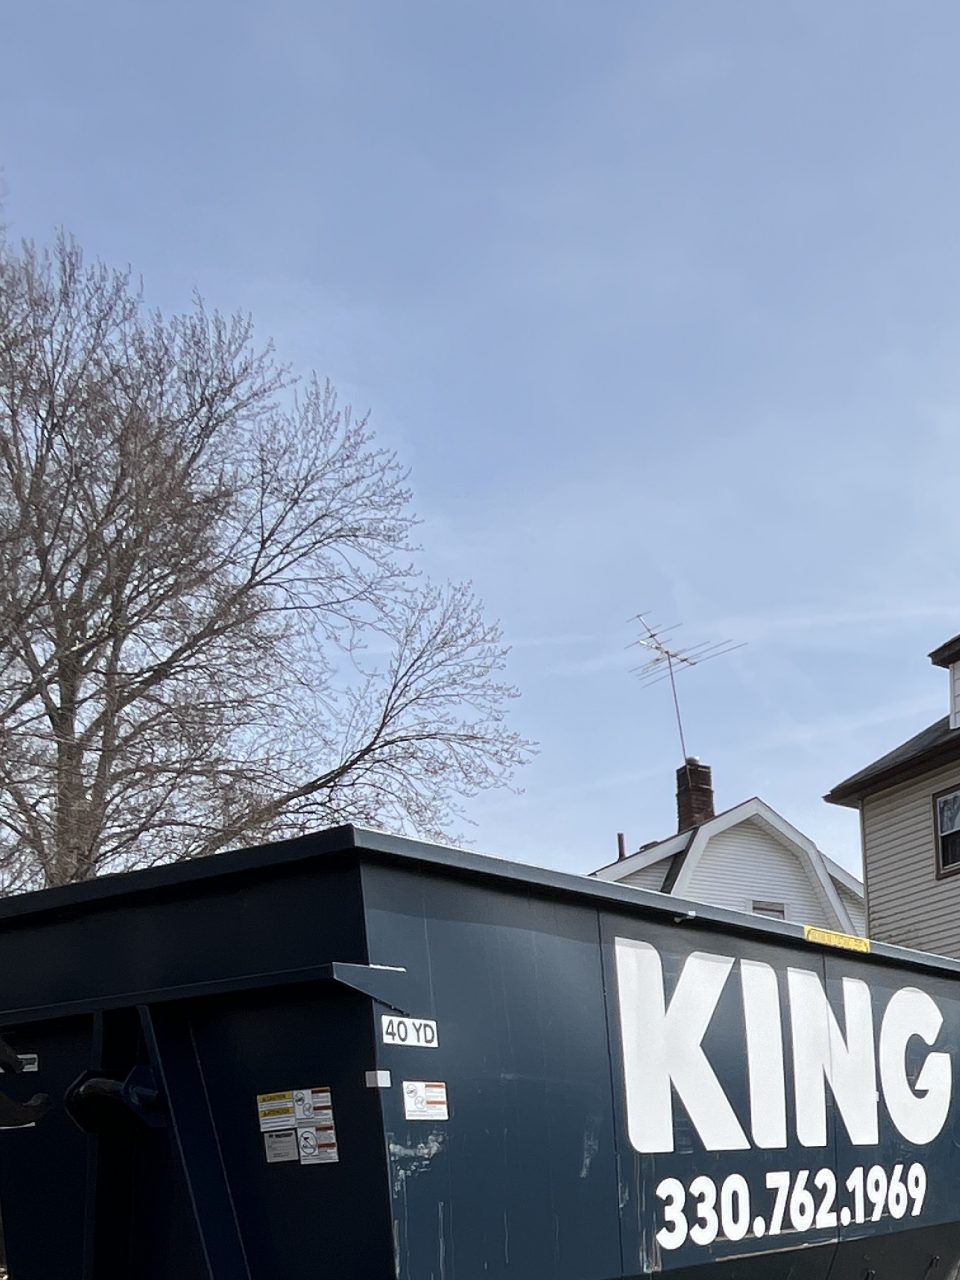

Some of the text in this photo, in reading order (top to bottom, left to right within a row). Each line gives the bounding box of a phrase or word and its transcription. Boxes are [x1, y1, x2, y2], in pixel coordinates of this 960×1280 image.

[386, 1019, 435, 1044] 40 YD
[614, 937, 952, 1153] KING
[655, 1163, 927, 1250] 330.762.1969
